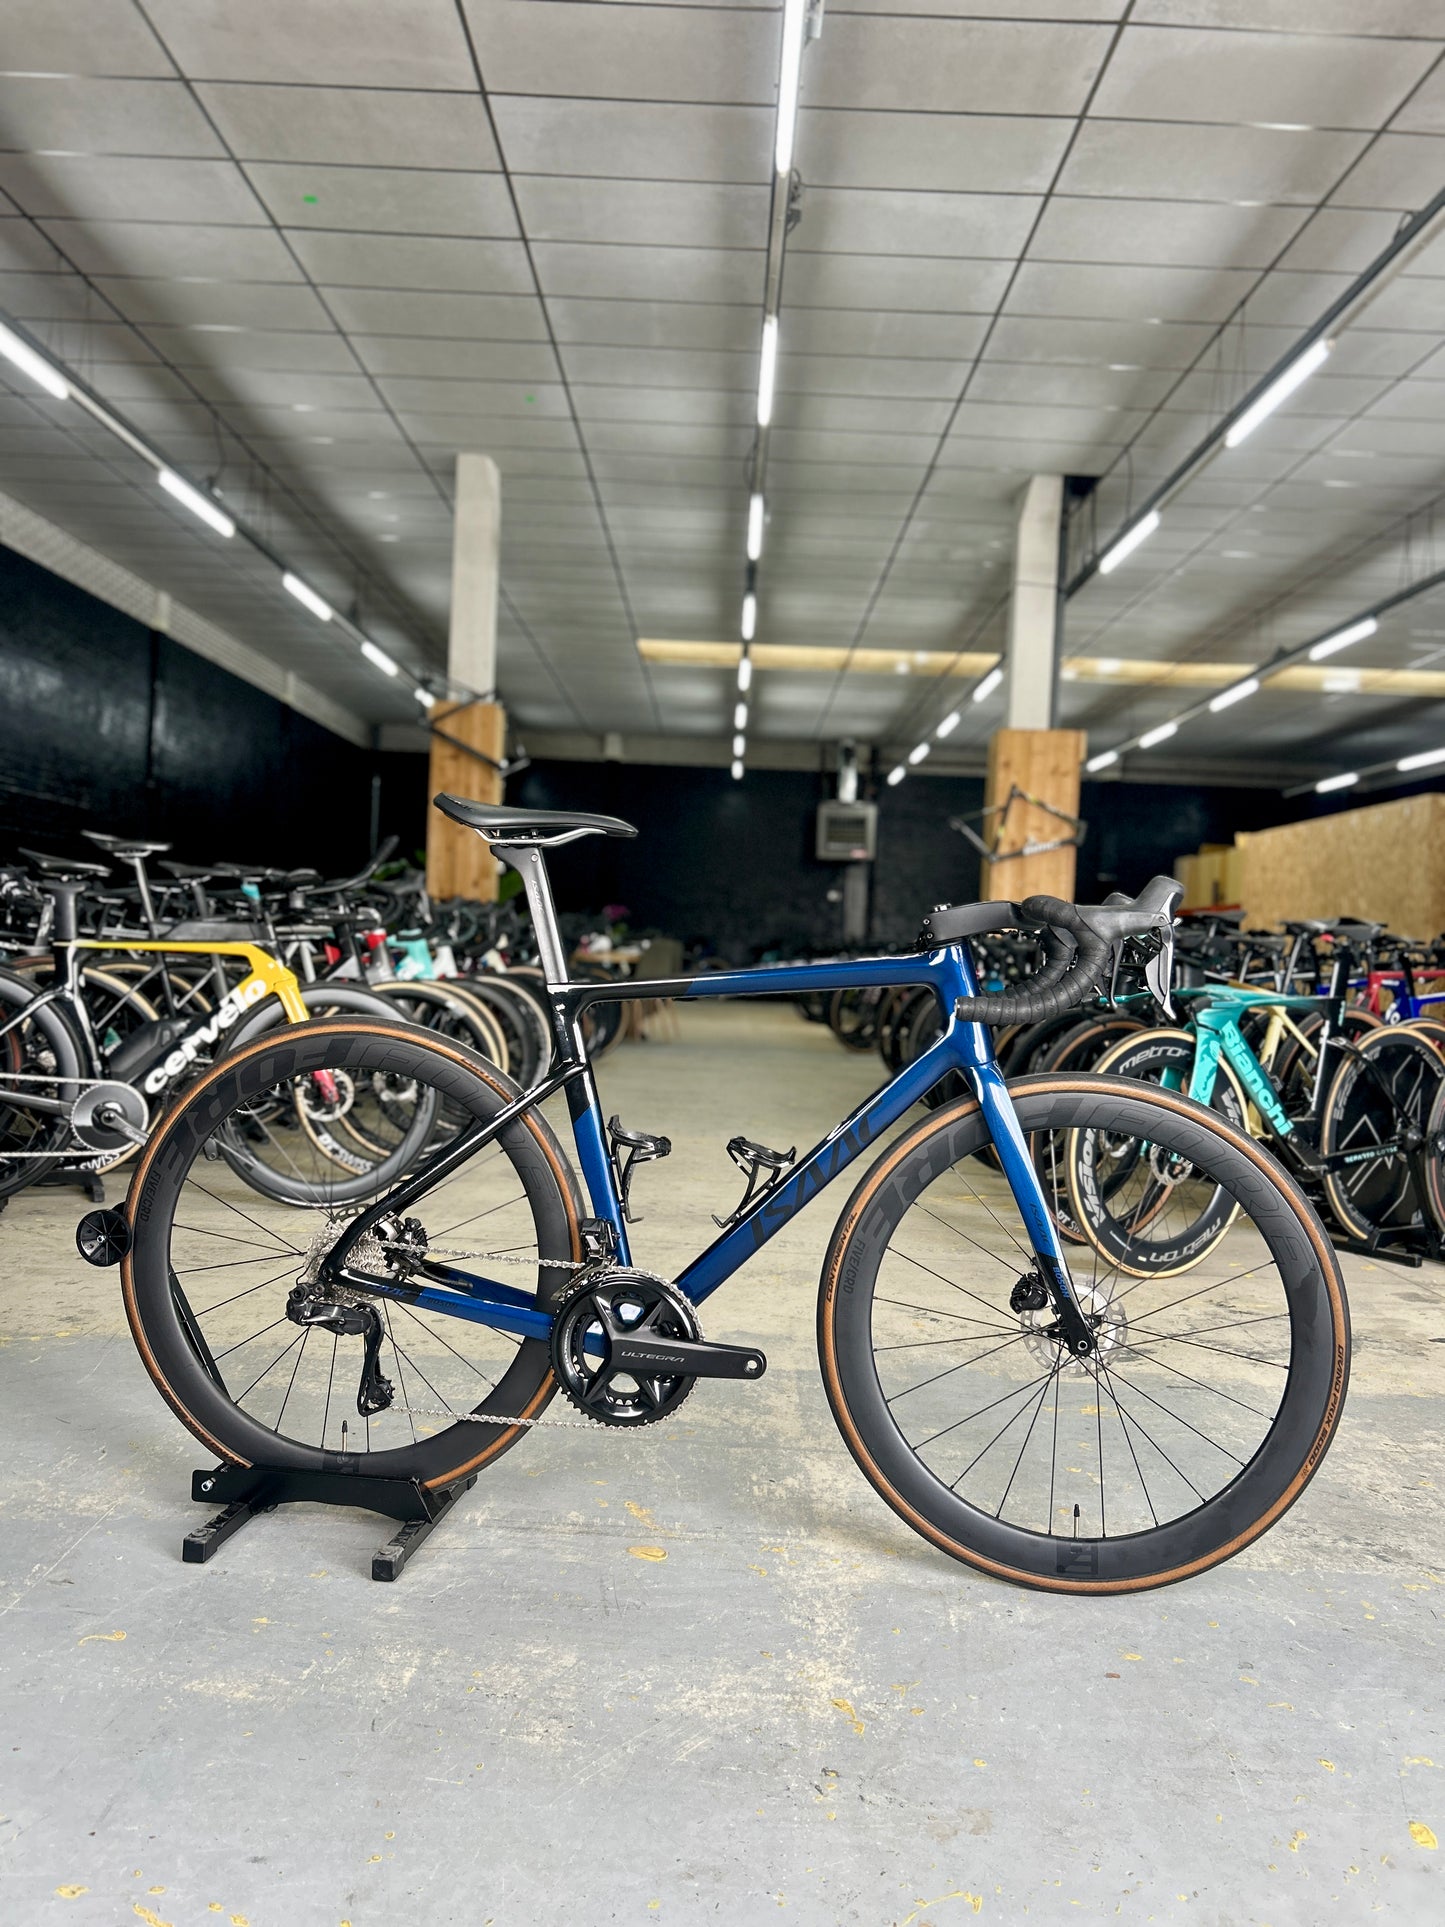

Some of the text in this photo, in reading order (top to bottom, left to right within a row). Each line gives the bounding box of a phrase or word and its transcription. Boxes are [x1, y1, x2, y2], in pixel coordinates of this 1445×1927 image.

[1221, 1019, 1295, 1136] Bianchi
[1057, 1209, 1071, 1224] DT
[825, 1211, 859, 1303] CONTINENTAL
[842, 1238, 867, 1295] FIVE/CRD
[1052, 1265, 1071, 1299] BOSON
[621, 1350, 685, 1363] ULTEGRA
[1308, 1344, 1344, 1467] GRAND PRIX 5000
